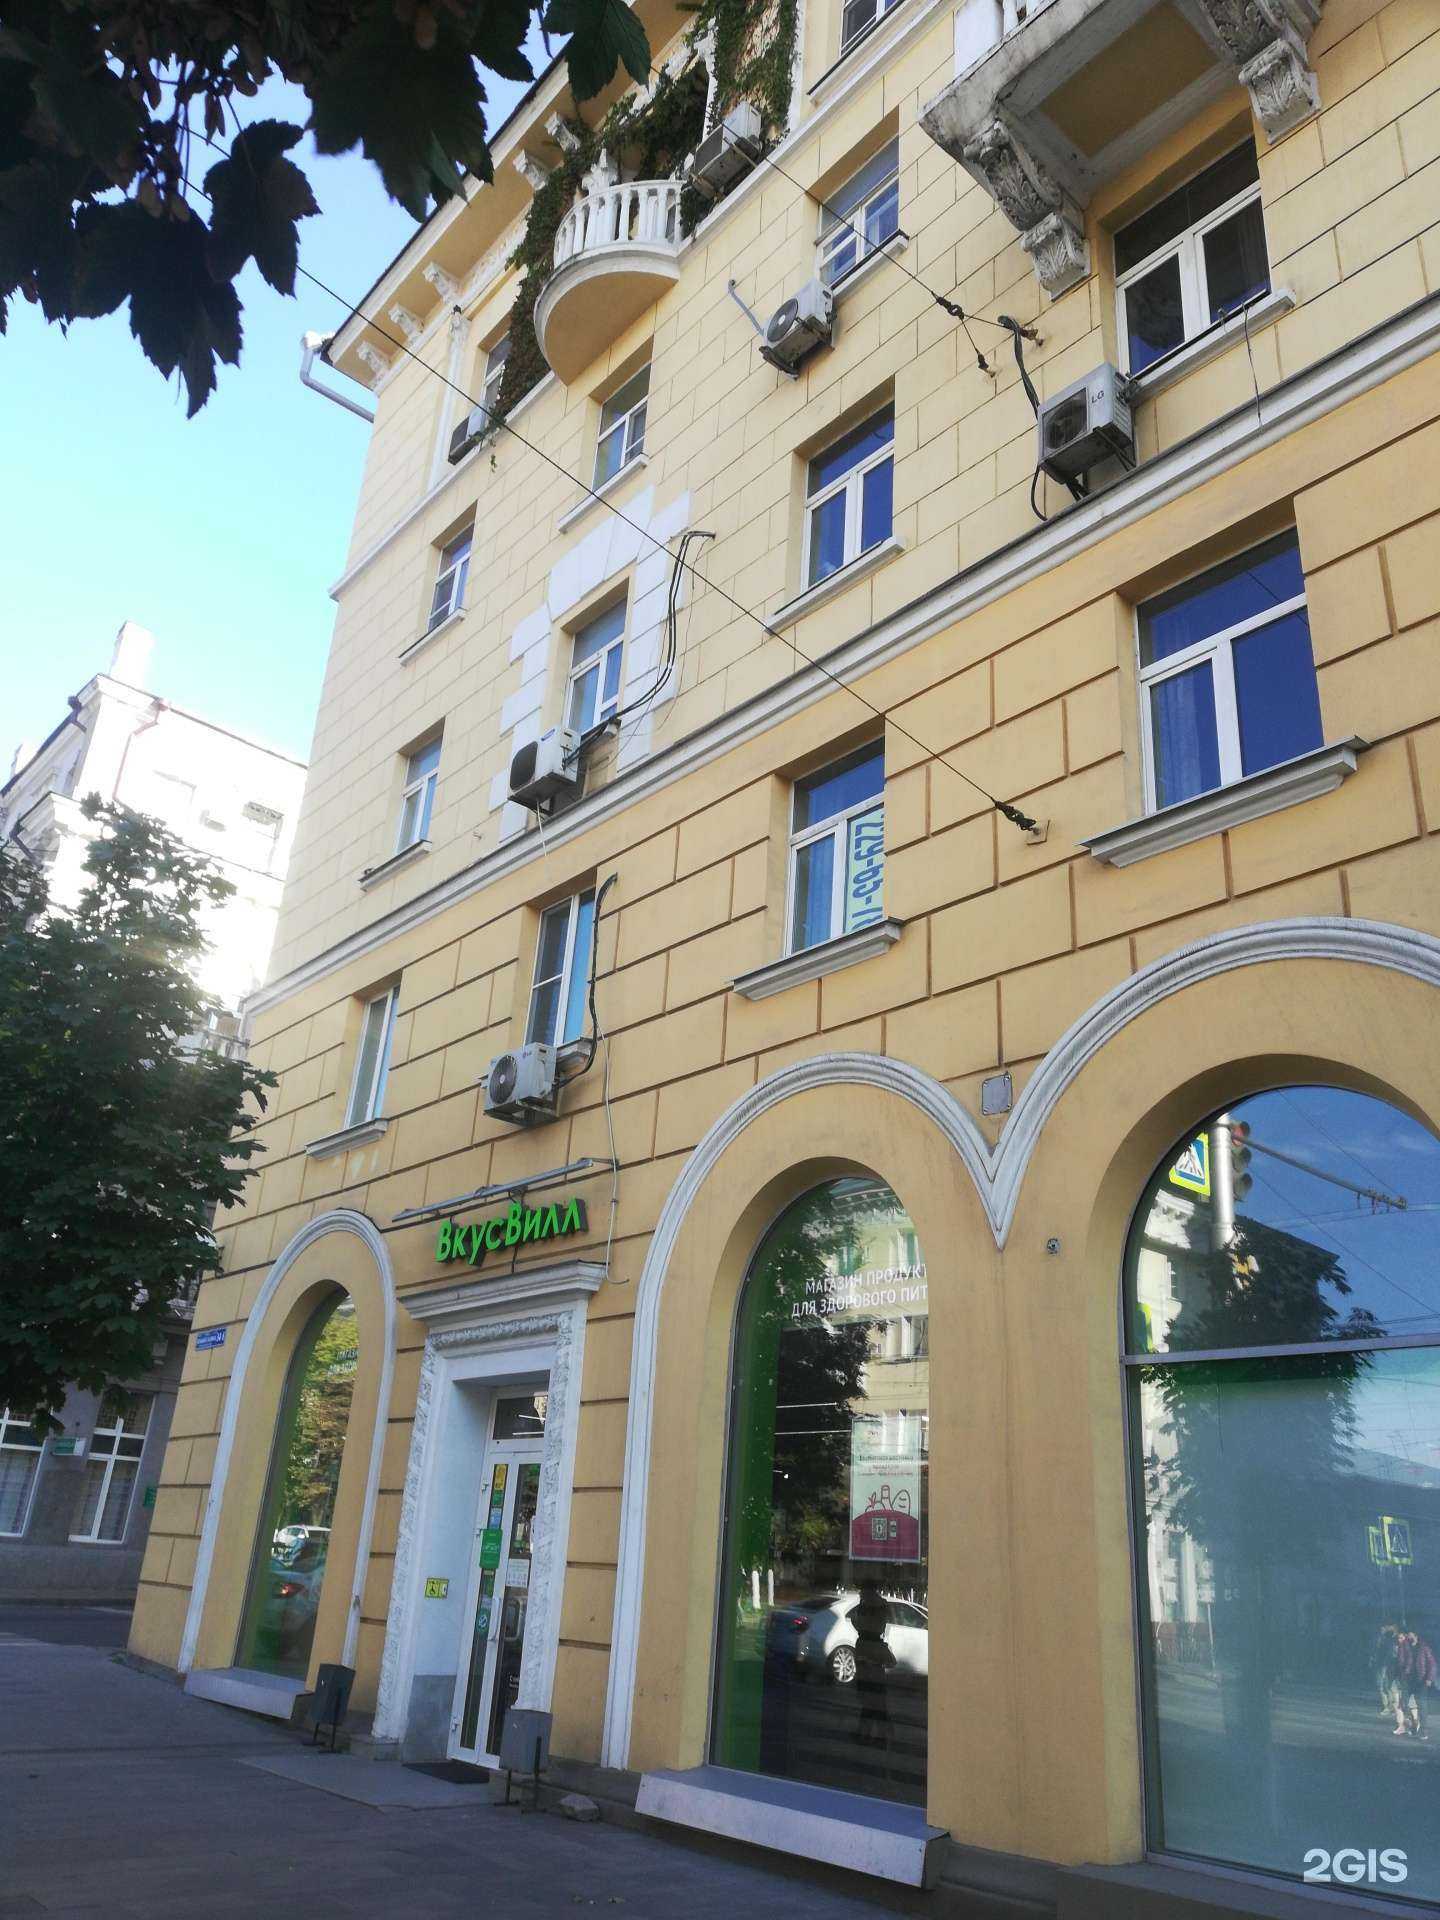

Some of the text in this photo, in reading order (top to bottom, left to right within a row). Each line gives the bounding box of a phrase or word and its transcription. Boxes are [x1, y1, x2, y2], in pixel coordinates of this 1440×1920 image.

[1091, 390, 1104, 404] LG
[434, 1196, 581, 1265] ВкусВилл
[804, 1273, 862, 1296] МАГАЗИН
[791, 1284, 928, 1319] ДЛЯ ЗДОРОВОГО ПИТ
